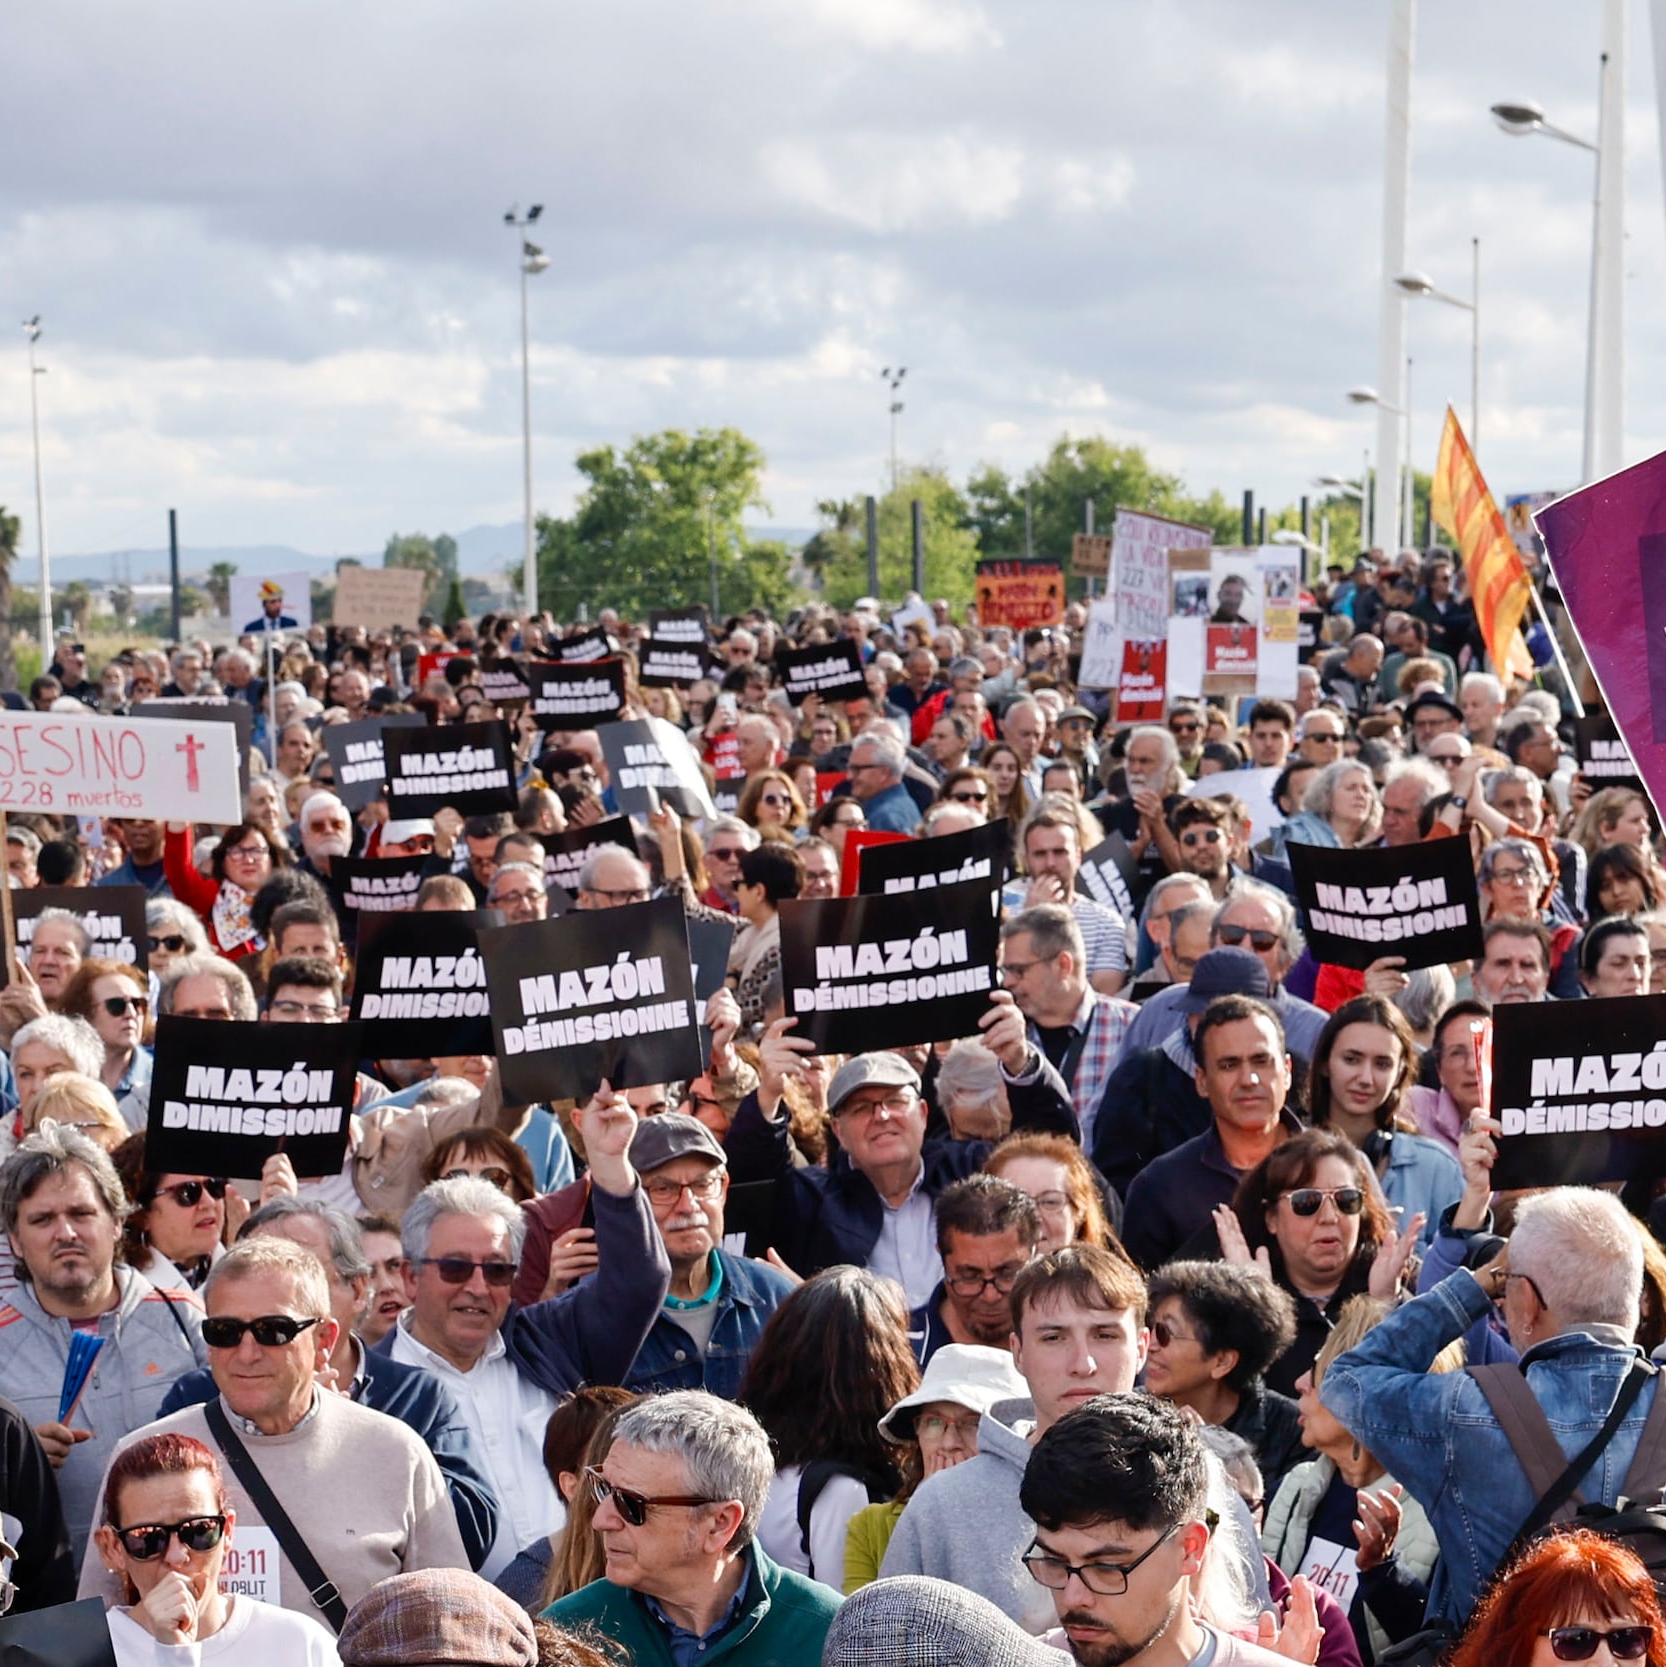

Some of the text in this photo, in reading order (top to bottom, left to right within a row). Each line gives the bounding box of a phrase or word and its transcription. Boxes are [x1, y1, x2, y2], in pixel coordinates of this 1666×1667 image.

[534, 691, 620, 715] DIMISSIÓ
[542, 676, 611, 698] MAZÓN
[400, 745, 496, 776] MAZÓN
[67, 783, 144, 809] muertos
[391, 769, 510, 796] DIMISSIONI
[350, 871, 422, 894] MAZÓ
[1315, 874, 1448, 914] MAZÓN
[17, 910, 122, 941] MÓN
[1308, 903, 1468, 943] DIMISSIONI
[380, 947, 485, 989] MAZÓ
[815, 927, 969, 980] MAZÓN
[519, 951, 665, 1014] MAZÓN
[793, 965, 992, 1013] DÉMISSIONNE
[502, 998, 691, 1057] DÉMISSIONNE
[185, 1060, 334, 1102] MAZÓN
[163, 1101, 343, 1138] DIMISSIONI
[1308, 1563, 1350, 1597] 20:11
